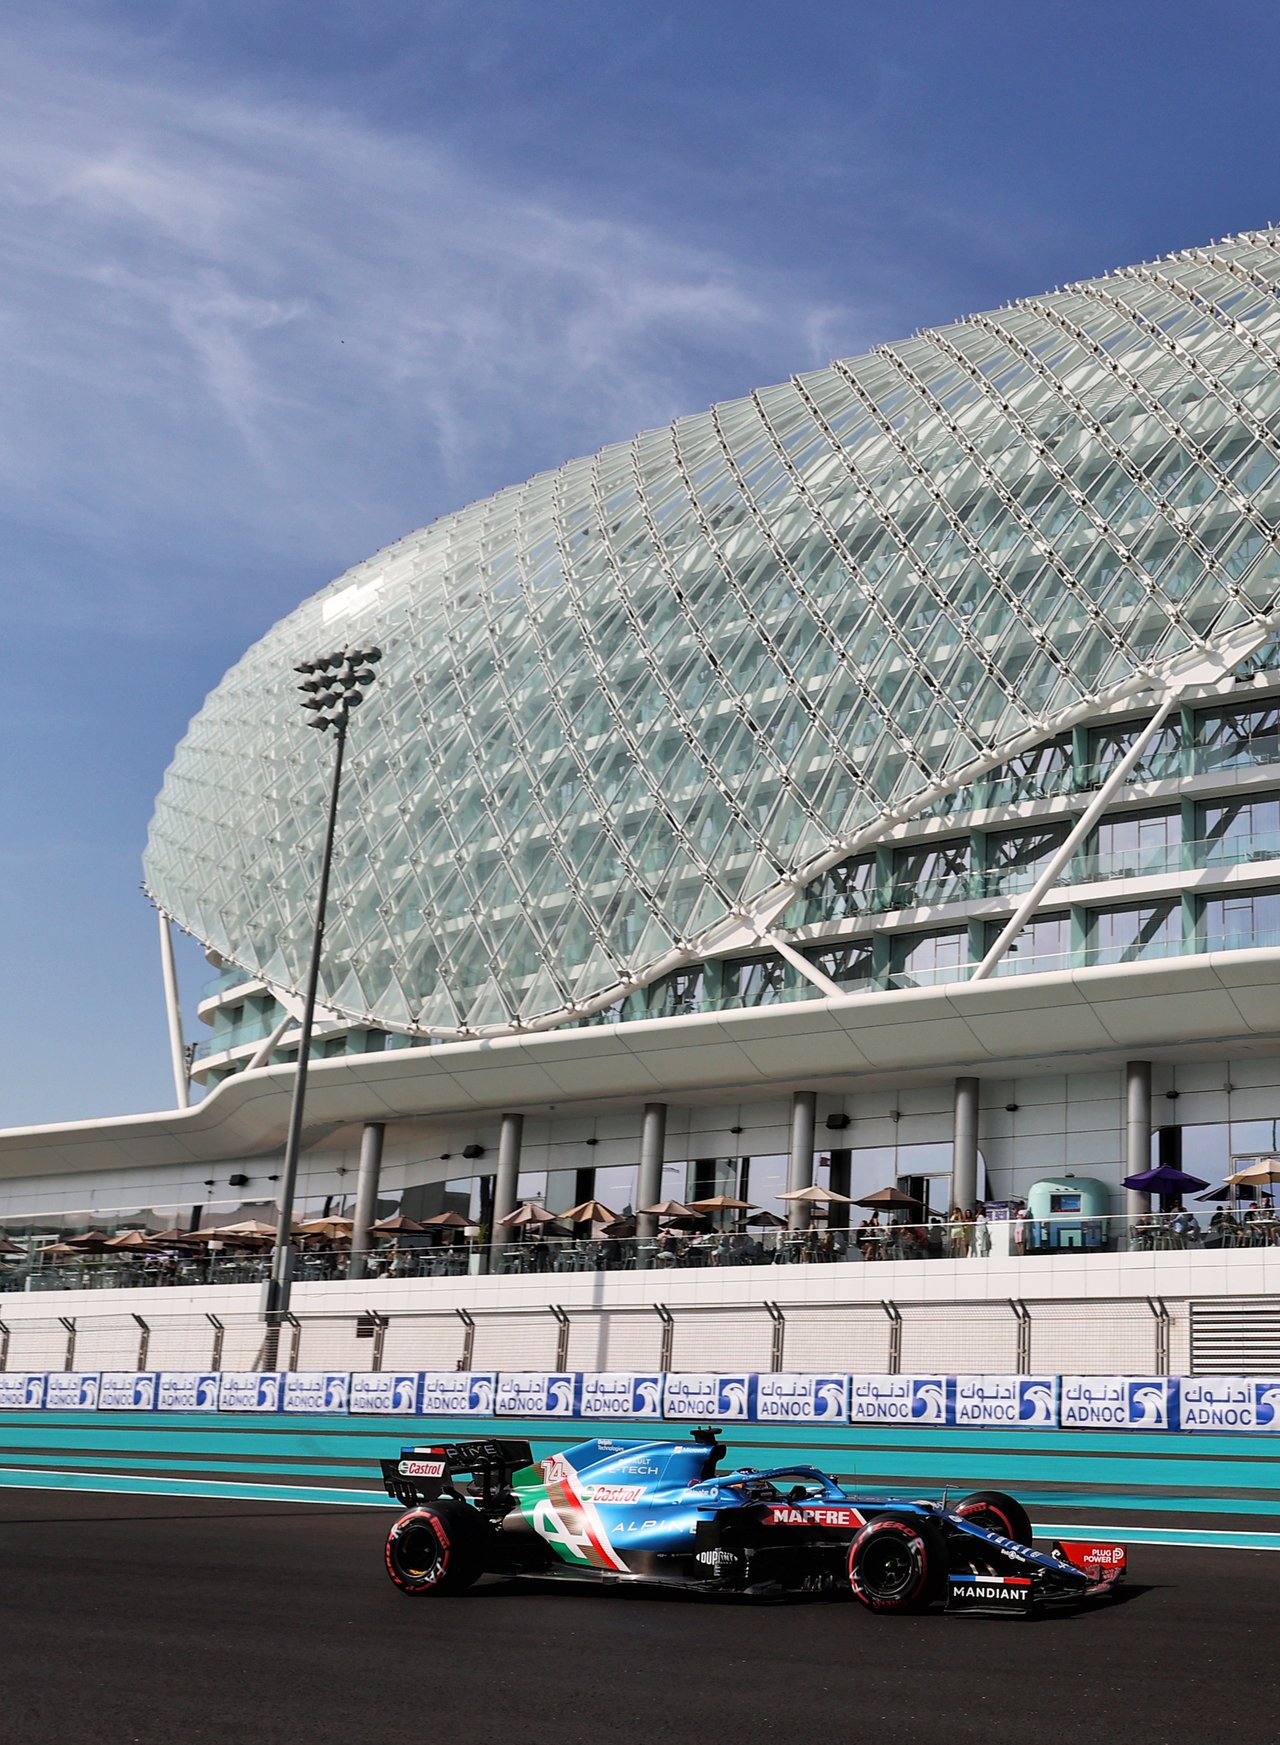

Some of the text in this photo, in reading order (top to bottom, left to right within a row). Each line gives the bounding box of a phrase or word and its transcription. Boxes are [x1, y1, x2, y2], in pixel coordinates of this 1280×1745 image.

[287, 1395, 323, 1408] ADNOC
[353, 1397, 390, 1409] ADNOC
[425, 1397, 467, 1410] ADNOC
[499, 1398, 543, 1411] ADNOC
[584, 1399, 630, 1412] ADNOC
[667, 1400, 715, 1415] ADNOC
[760, 1401, 811, 1416] ADNOC
[856, 1403, 909, 1418] ADNOC
[960, 1405, 1016, 1420] ADNOC
[1066, 1407, 1125, 1423] ADNOC
[1185, 1409, 1252, 1425] ADNOC
[408, 1463, 441, 1475] Castrol
[593, 1486, 638, 1502] Castrol
[773, 1509, 850, 1526] MAPFRE
[1083, 1555, 1112, 1564] POWER
[953, 1586, 1029, 1600] MANDIANT
